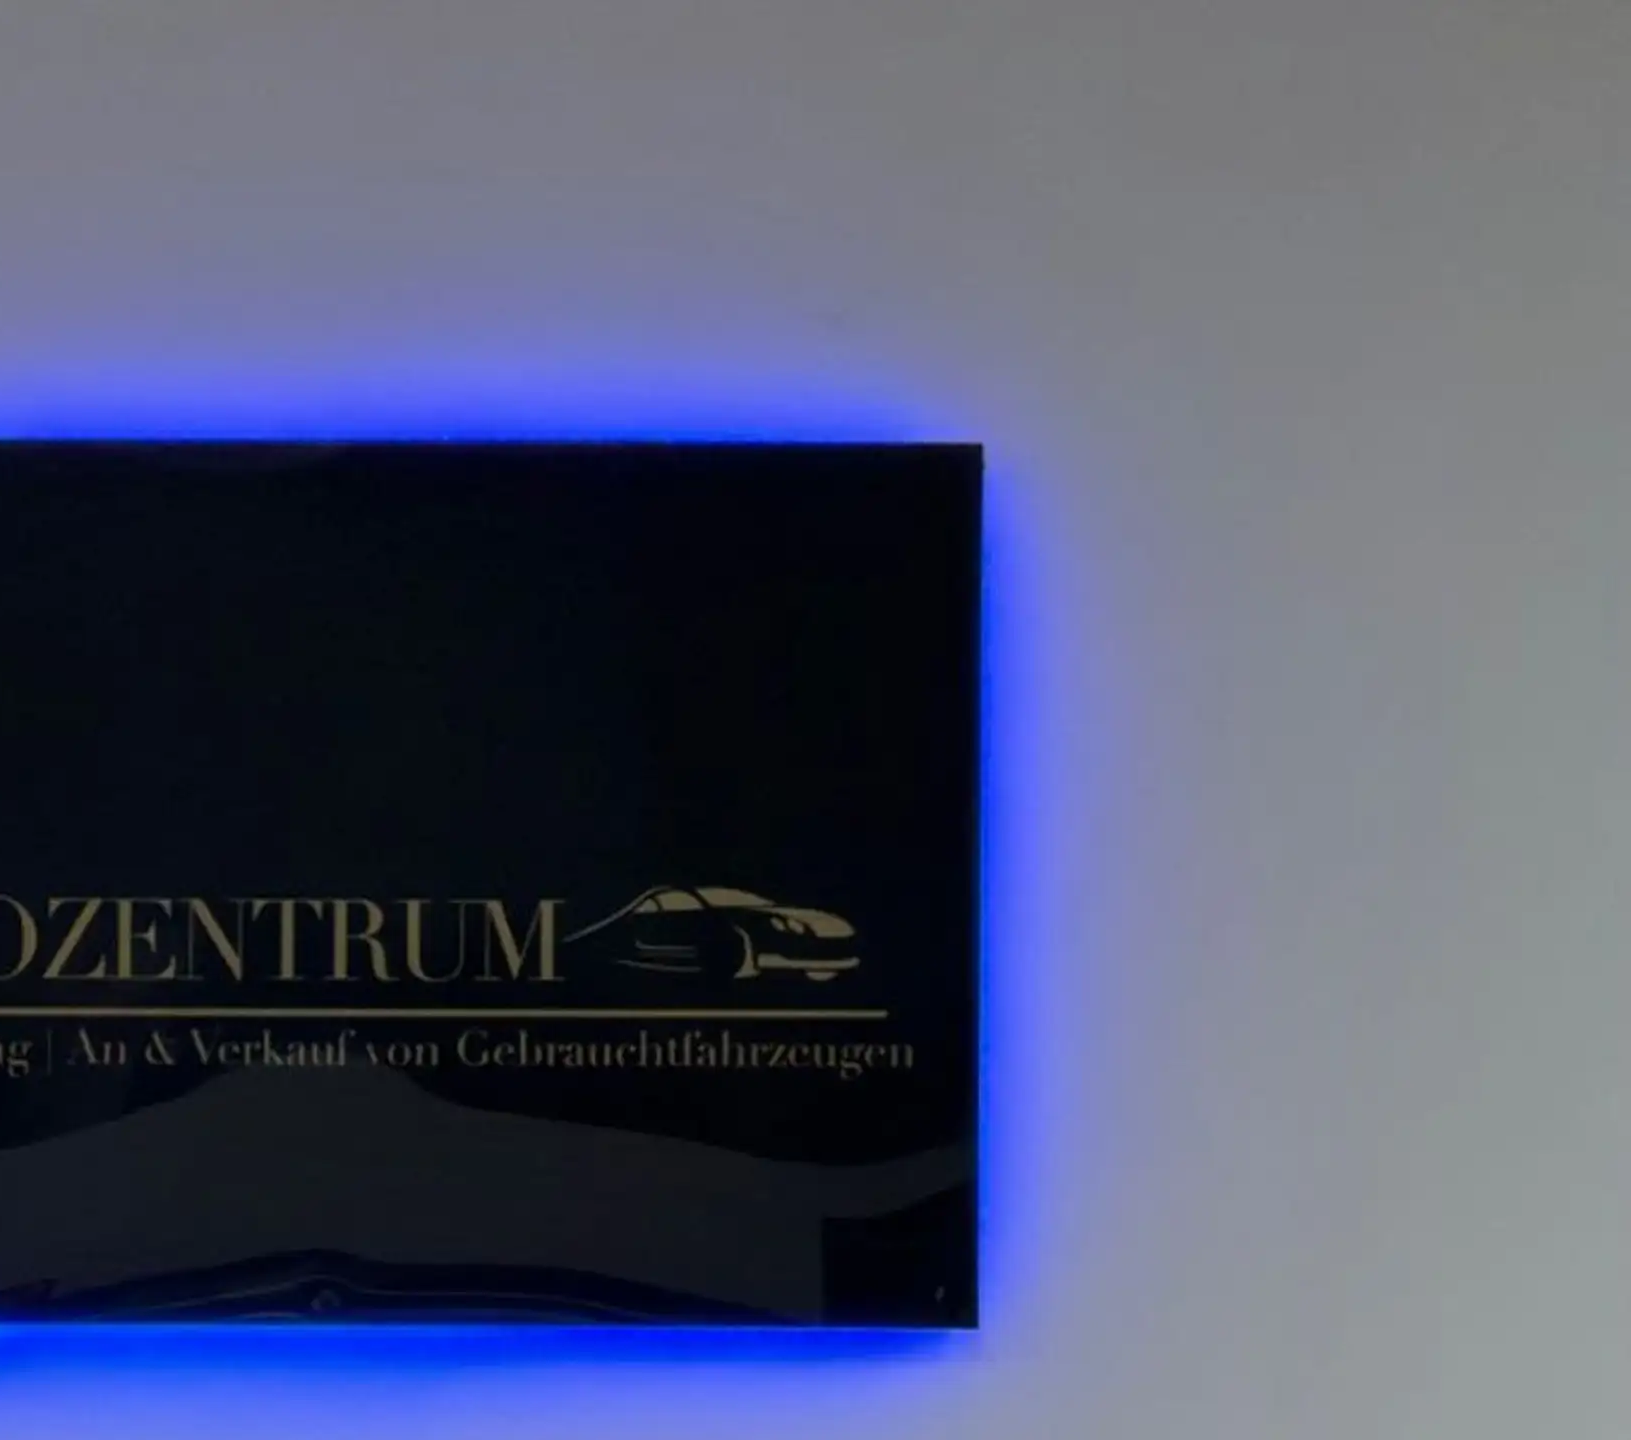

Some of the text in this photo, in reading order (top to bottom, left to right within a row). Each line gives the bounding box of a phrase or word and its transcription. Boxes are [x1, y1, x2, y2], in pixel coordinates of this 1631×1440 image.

[66, 1027, 127, 1066] An
[144, 1029, 178, 1067] &
[189, 1028, 355, 1067] Verkauf
[365, 1037, 440, 1068] von
[456, 1028, 914, 1080] Gebrauchtfahrzeugen
